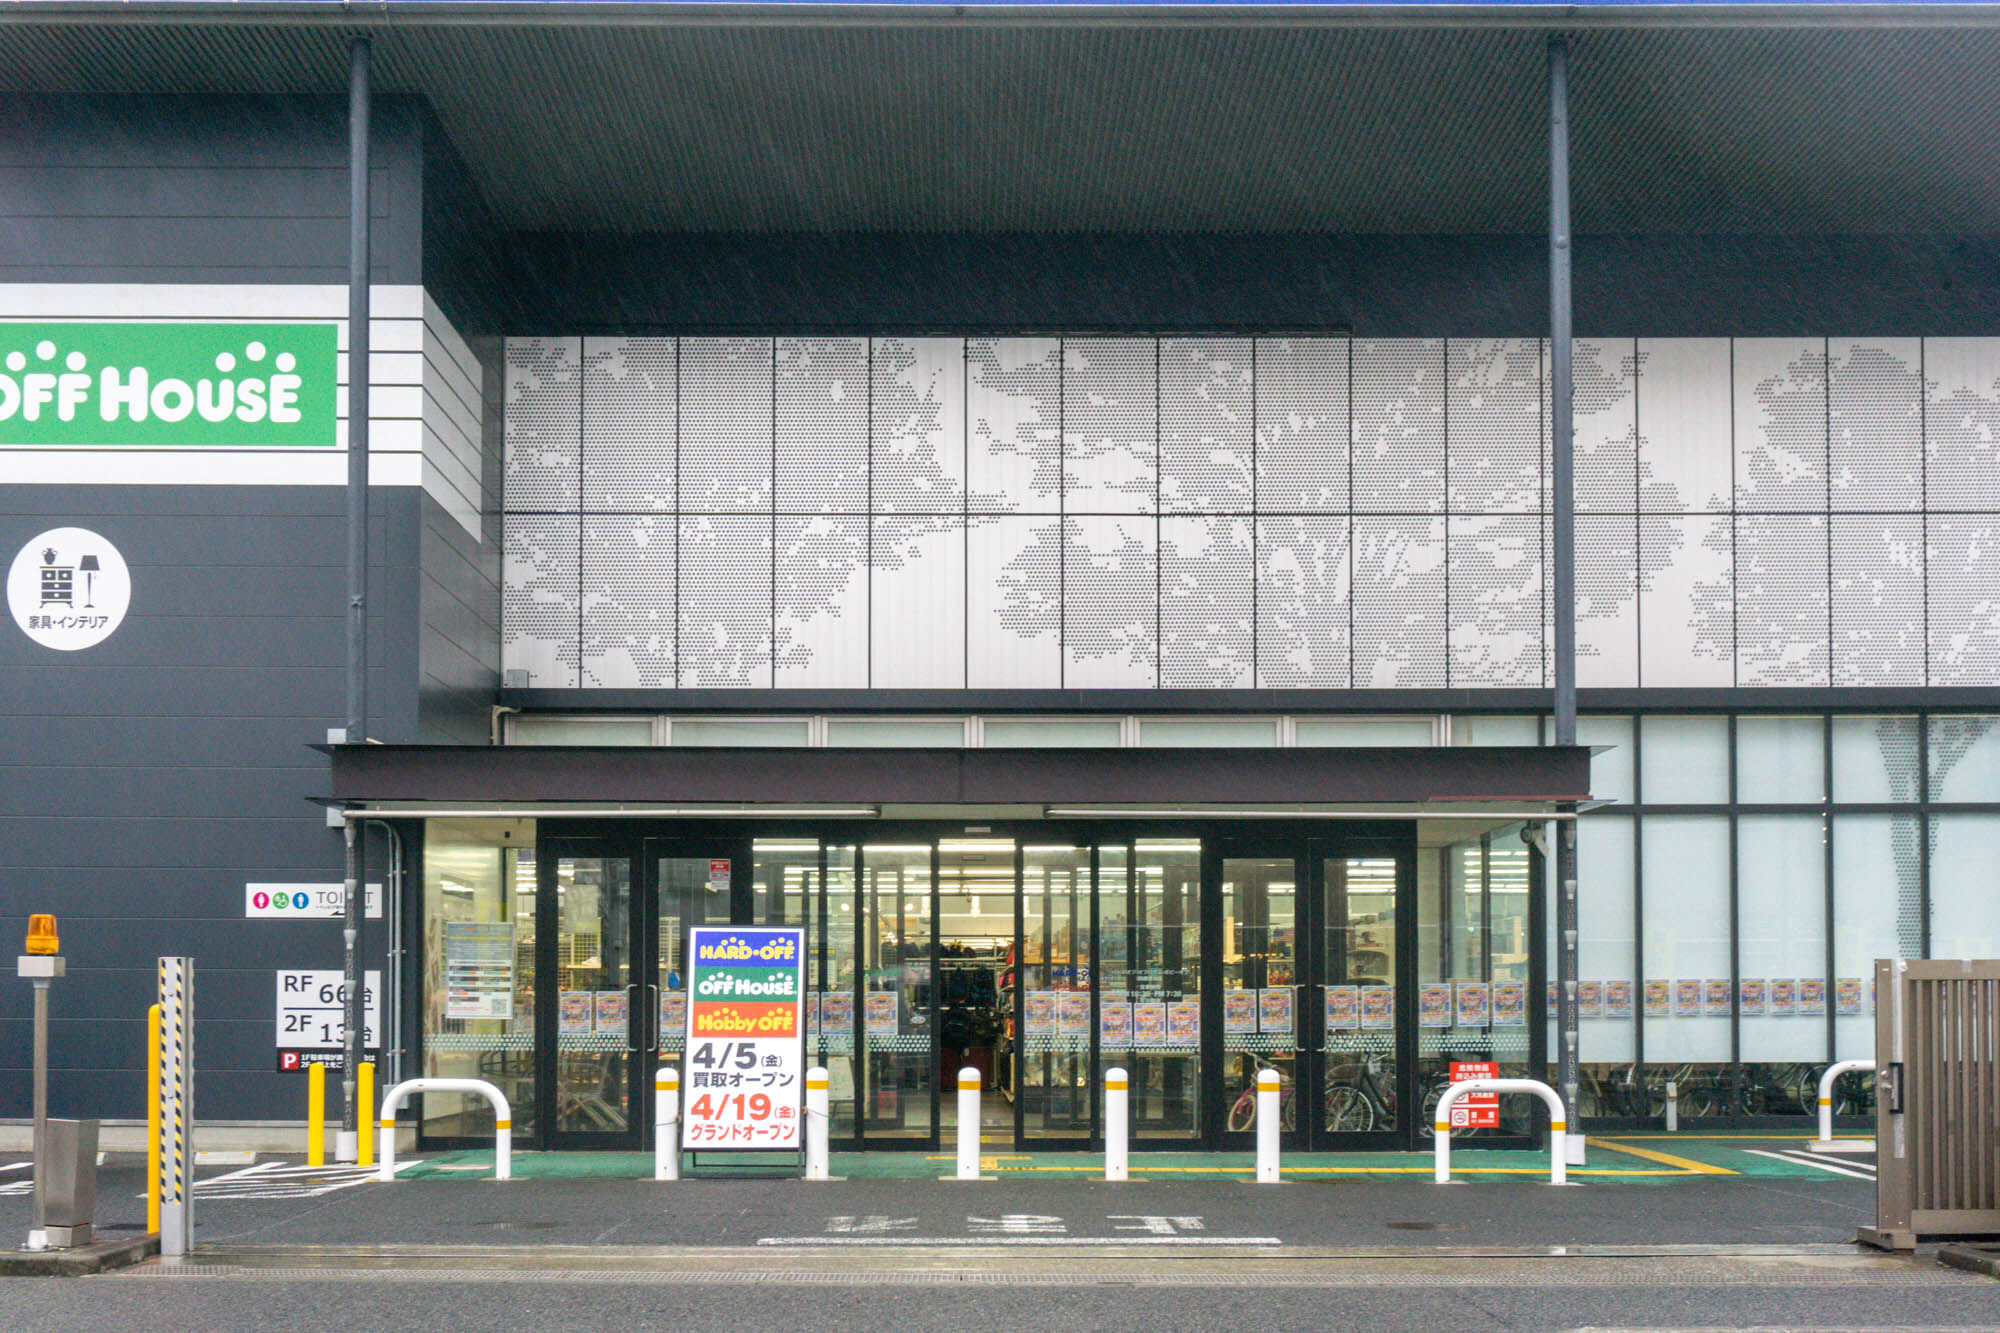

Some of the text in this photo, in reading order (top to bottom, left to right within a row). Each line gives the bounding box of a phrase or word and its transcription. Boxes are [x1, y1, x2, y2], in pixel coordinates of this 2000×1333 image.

[29, 615, 109, 629] 家具・インテリア
[316, 891, 374, 904] TOIT
[285, 975, 313, 992] RF
[285, 1015, 312, 1032] 2F
[698, 1014, 757, 1032] Hobby
[693, 1072, 794, 1088] 買取オープン
[691, 1123, 795, 1141] グランドオープン
